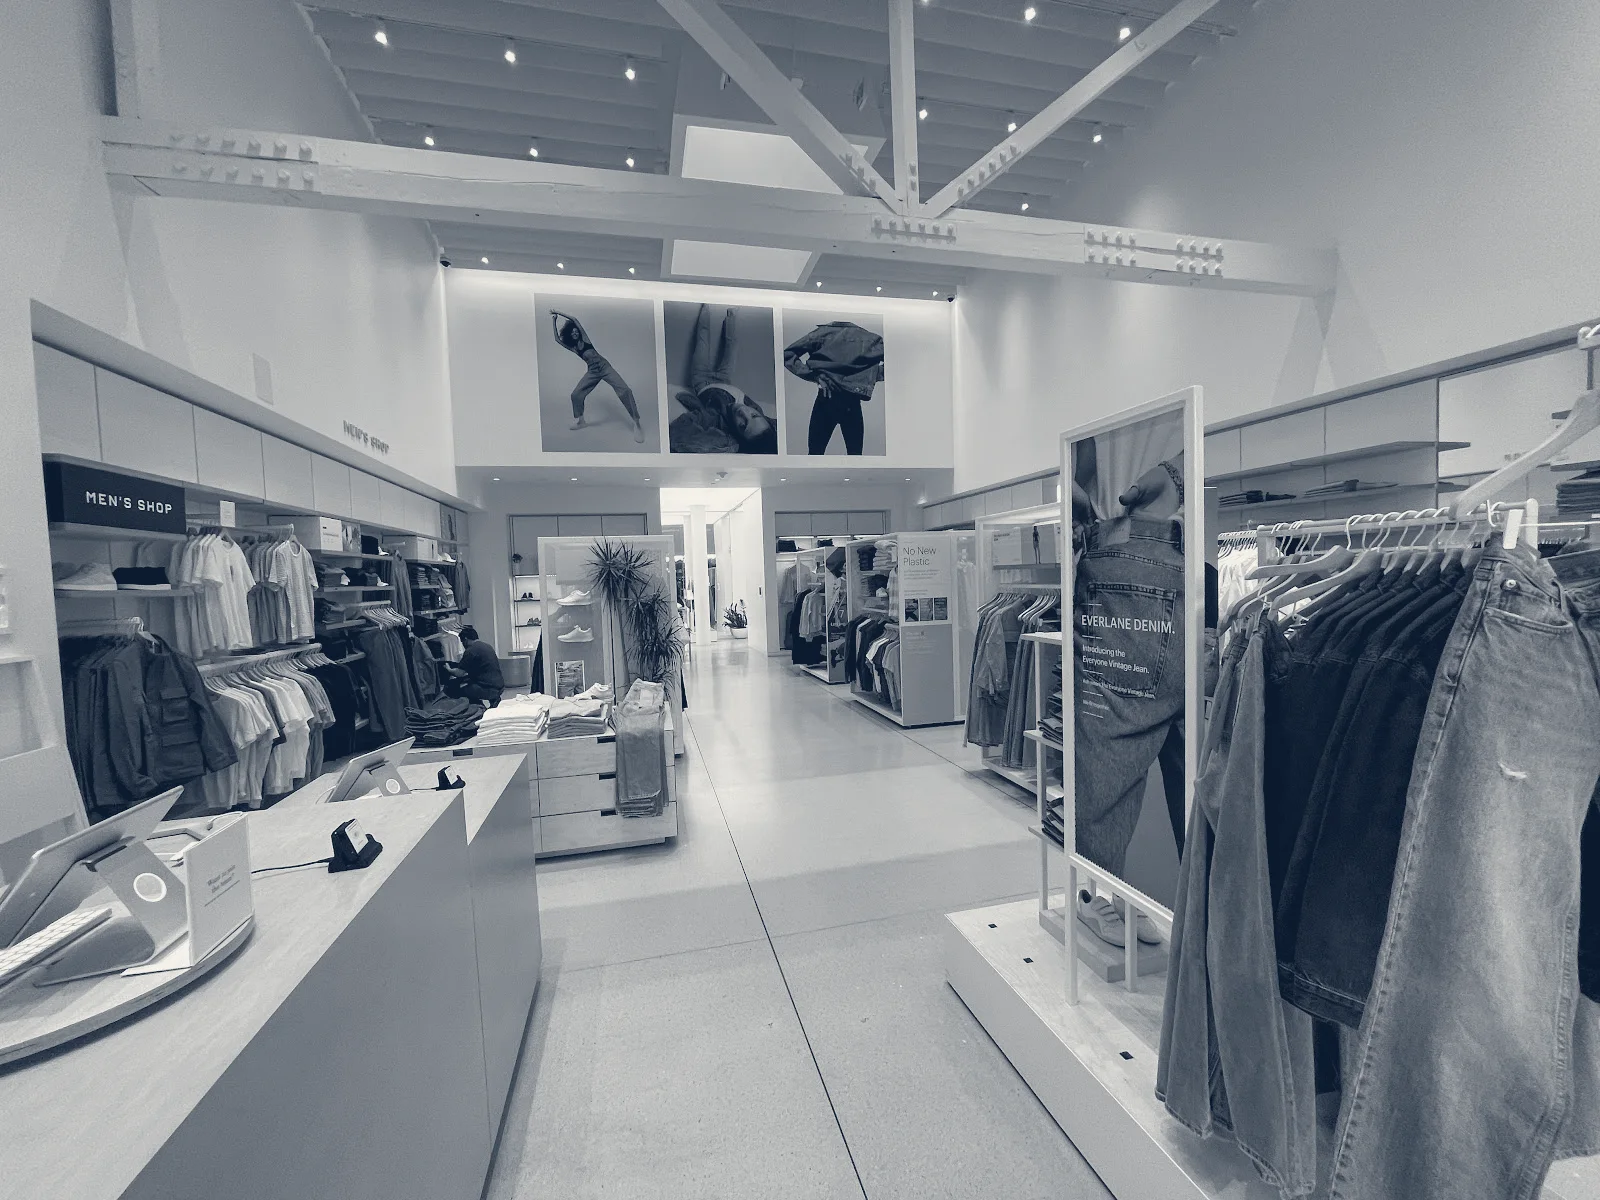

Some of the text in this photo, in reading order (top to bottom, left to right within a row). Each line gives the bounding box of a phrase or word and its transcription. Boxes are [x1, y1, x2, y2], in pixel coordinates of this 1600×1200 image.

[86, 491, 173, 514] MEN'S SHOP
[903, 546, 937, 555] No New
[903, 557, 930, 566] Plastic
[1081, 614, 1175, 634] EVERLANE DENIM.
[1082, 644, 1126, 658] Introducing the
[1082, 655, 1150, 674] Everyone Vintage Jean.
